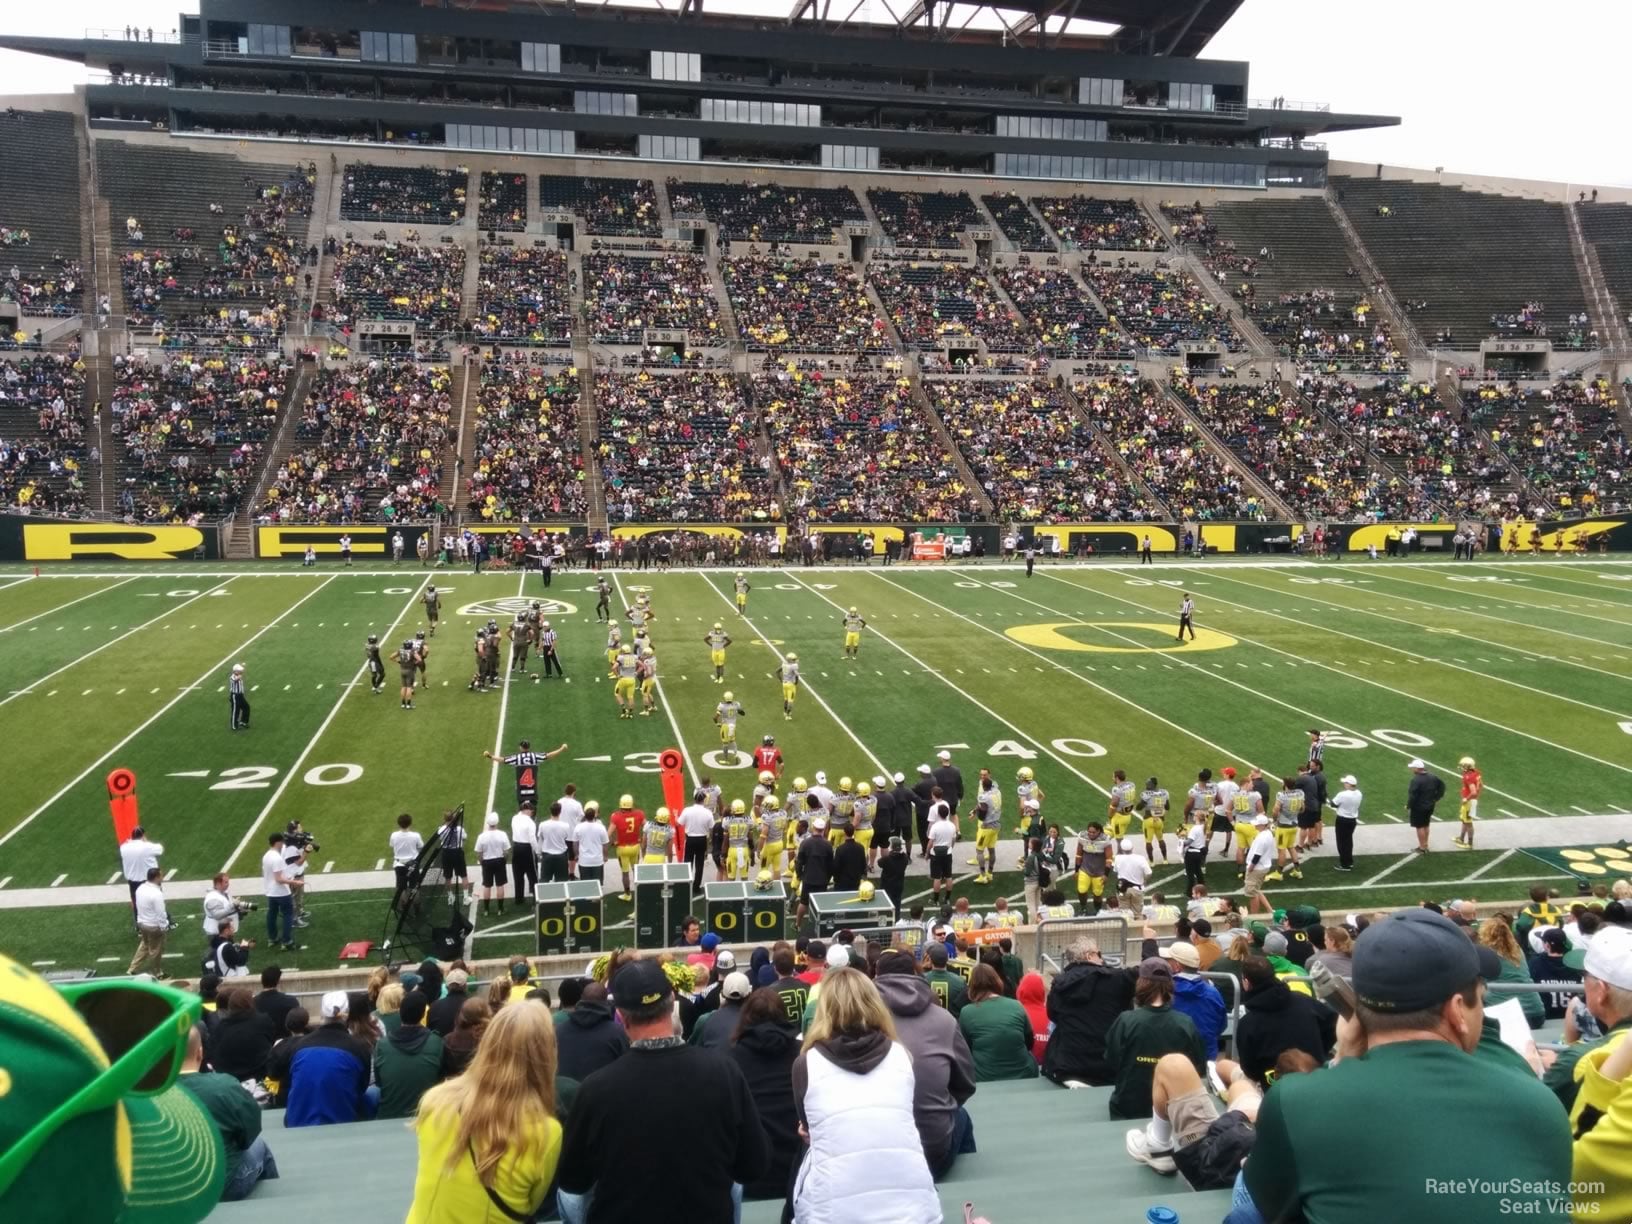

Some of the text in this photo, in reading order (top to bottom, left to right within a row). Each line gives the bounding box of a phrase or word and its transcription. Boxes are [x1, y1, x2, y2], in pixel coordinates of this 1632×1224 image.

[364, 324, 408, 333] 27 28 29
[660, 332, 671, 341] 30
[987, 738, 1108, 759] 40
[762, 751, 777, 765] 17
[208, 763, 364, 790] 20
[519, 767, 536, 788] 4
[625, 816, 635, 833] 3
[541, 918, 564, 936] O
[574, 915, 597, 933] O
[715, 912, 737, 930] O
[755, 911, 777, 928] O
[1550, 991, 1572, 1008] 16
